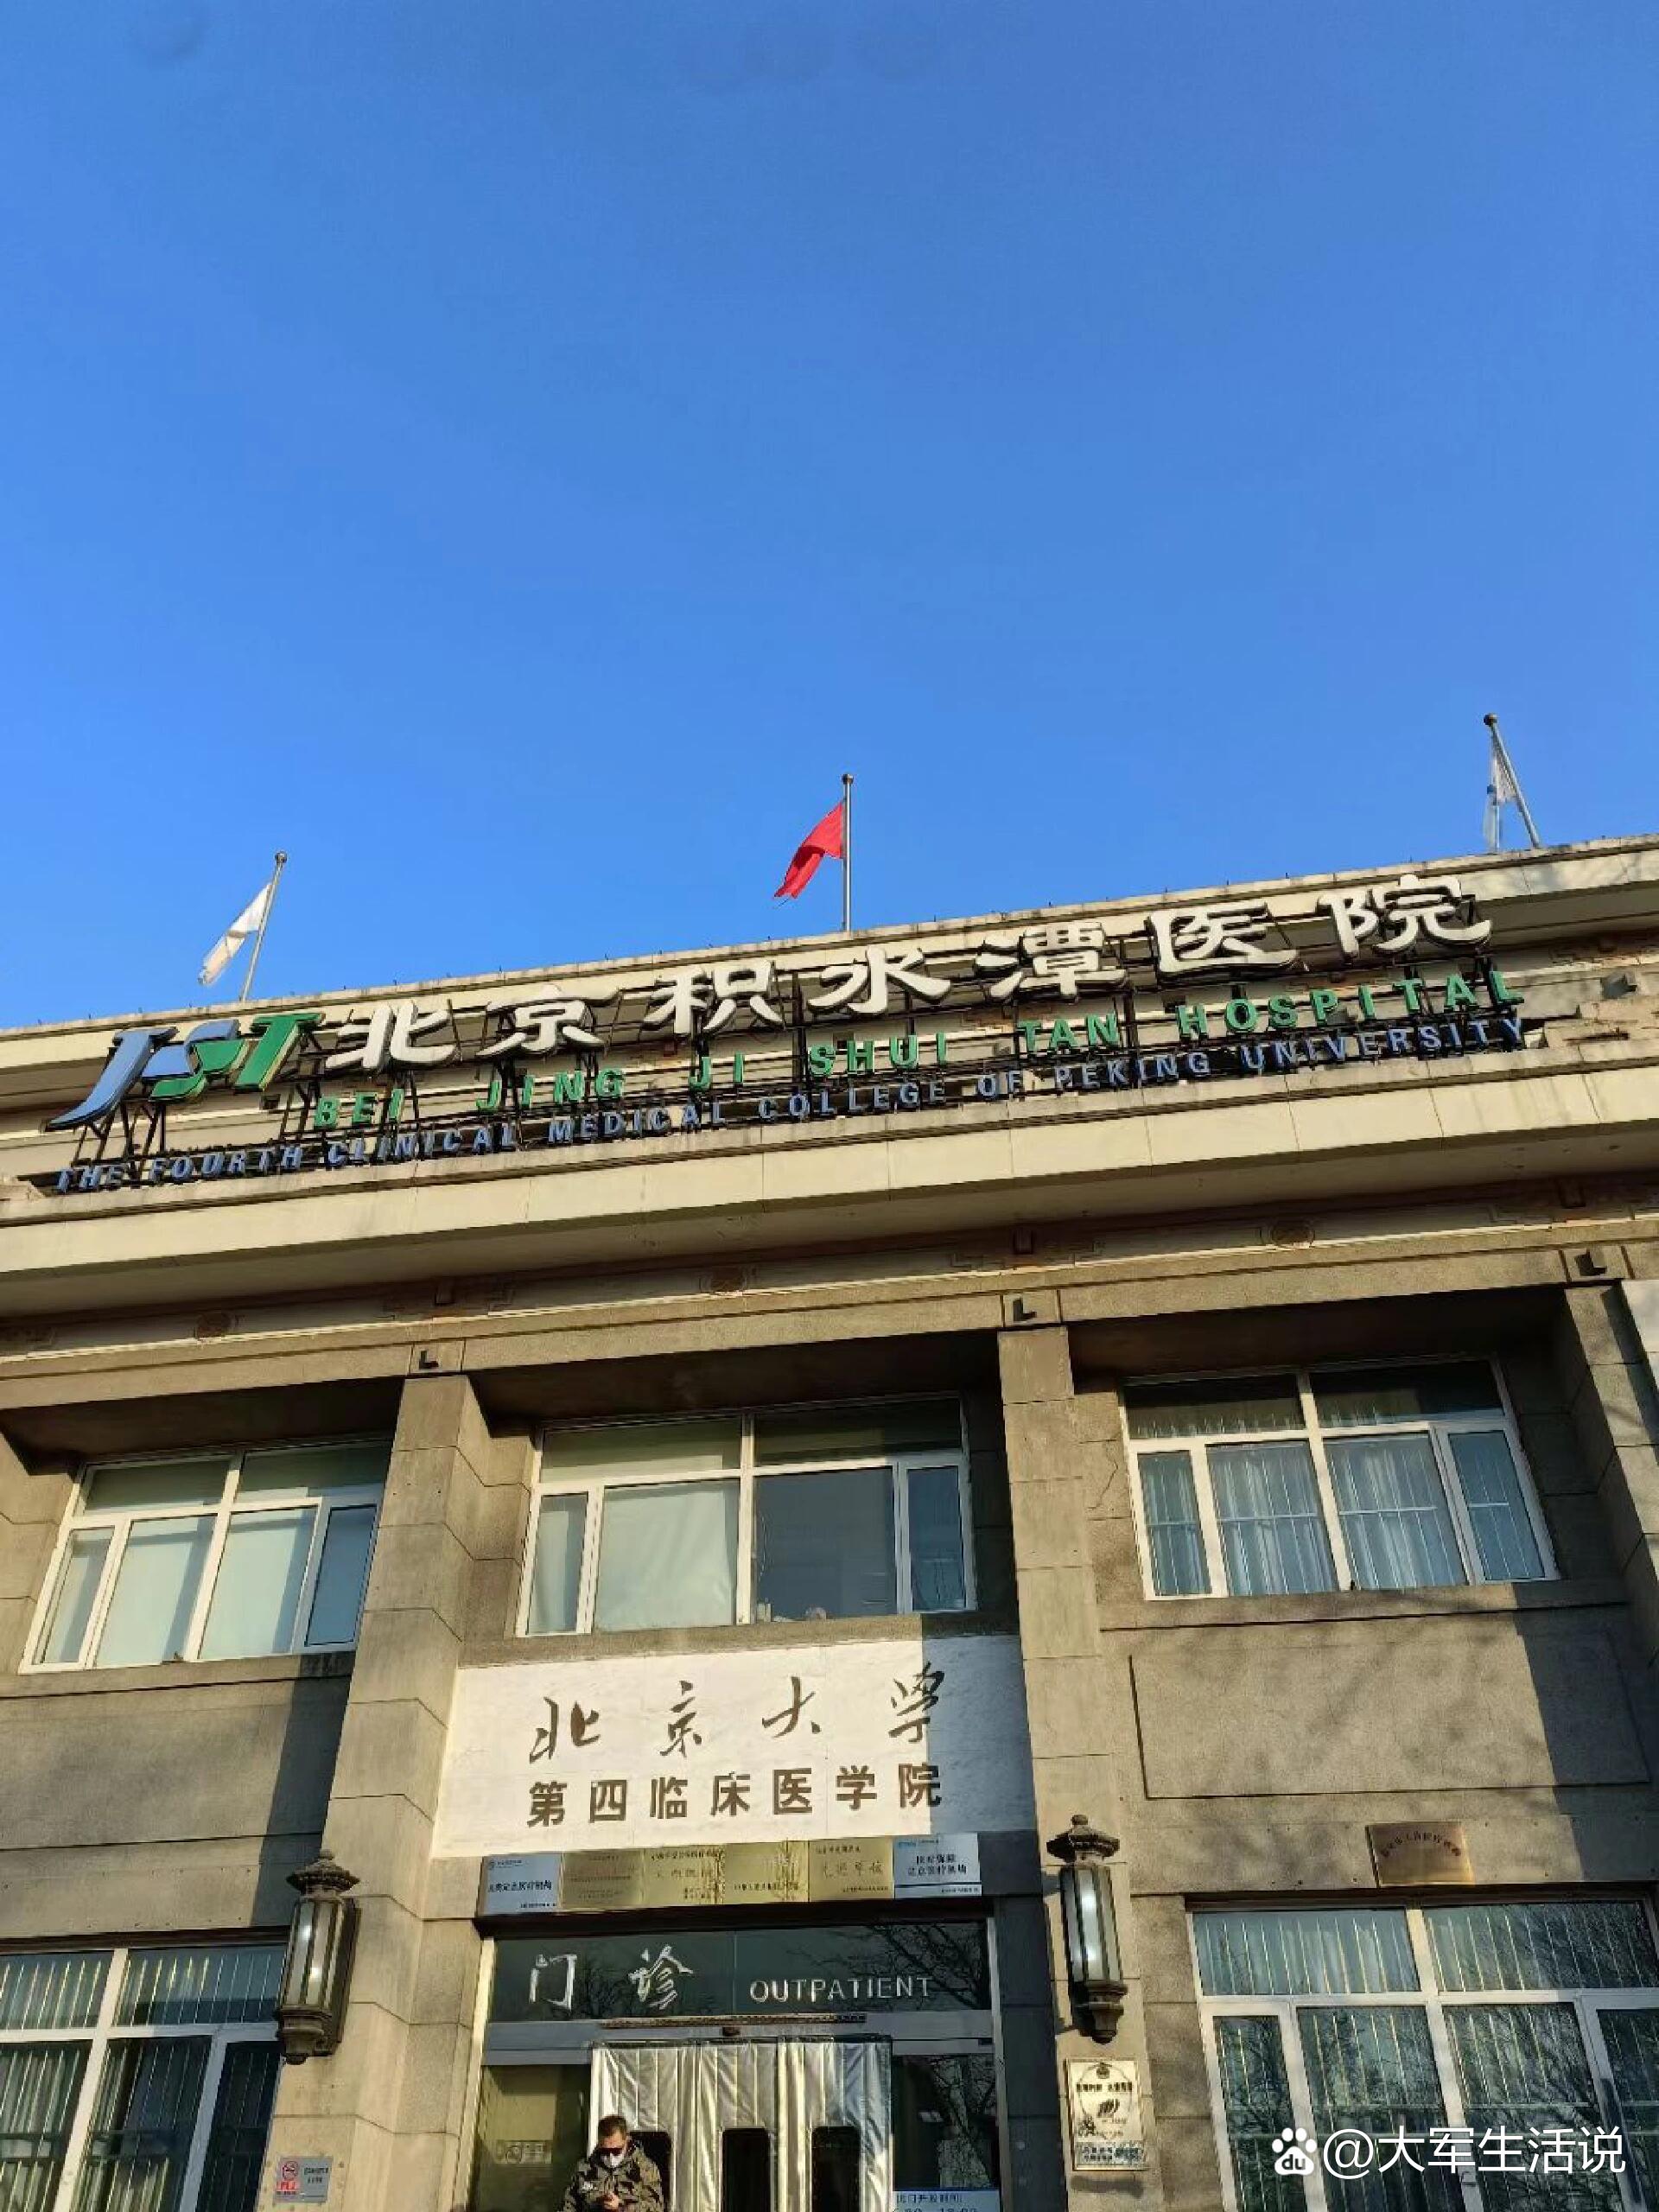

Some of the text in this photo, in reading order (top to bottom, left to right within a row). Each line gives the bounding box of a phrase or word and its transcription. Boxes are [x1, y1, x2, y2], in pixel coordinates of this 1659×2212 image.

[323, 874, 1491, 1071] 北京积水潭医院
[313, 969, 1524, 1131] BEI JING JI SHUI TAN HOSPITAL
[56, 1018, 1523, 1193] THE FOURTH CLINICAL MEDICAL COLLEGE OF PEKING UNIVERSITY
[529, 1661, 944, 1764] 北京大学
[526, 1763, 942, 1827] 第四临床医学院
[529, 1943, 693, 2012] 门诊
[749, 1976, 932, 2003] OUTPATIENT
